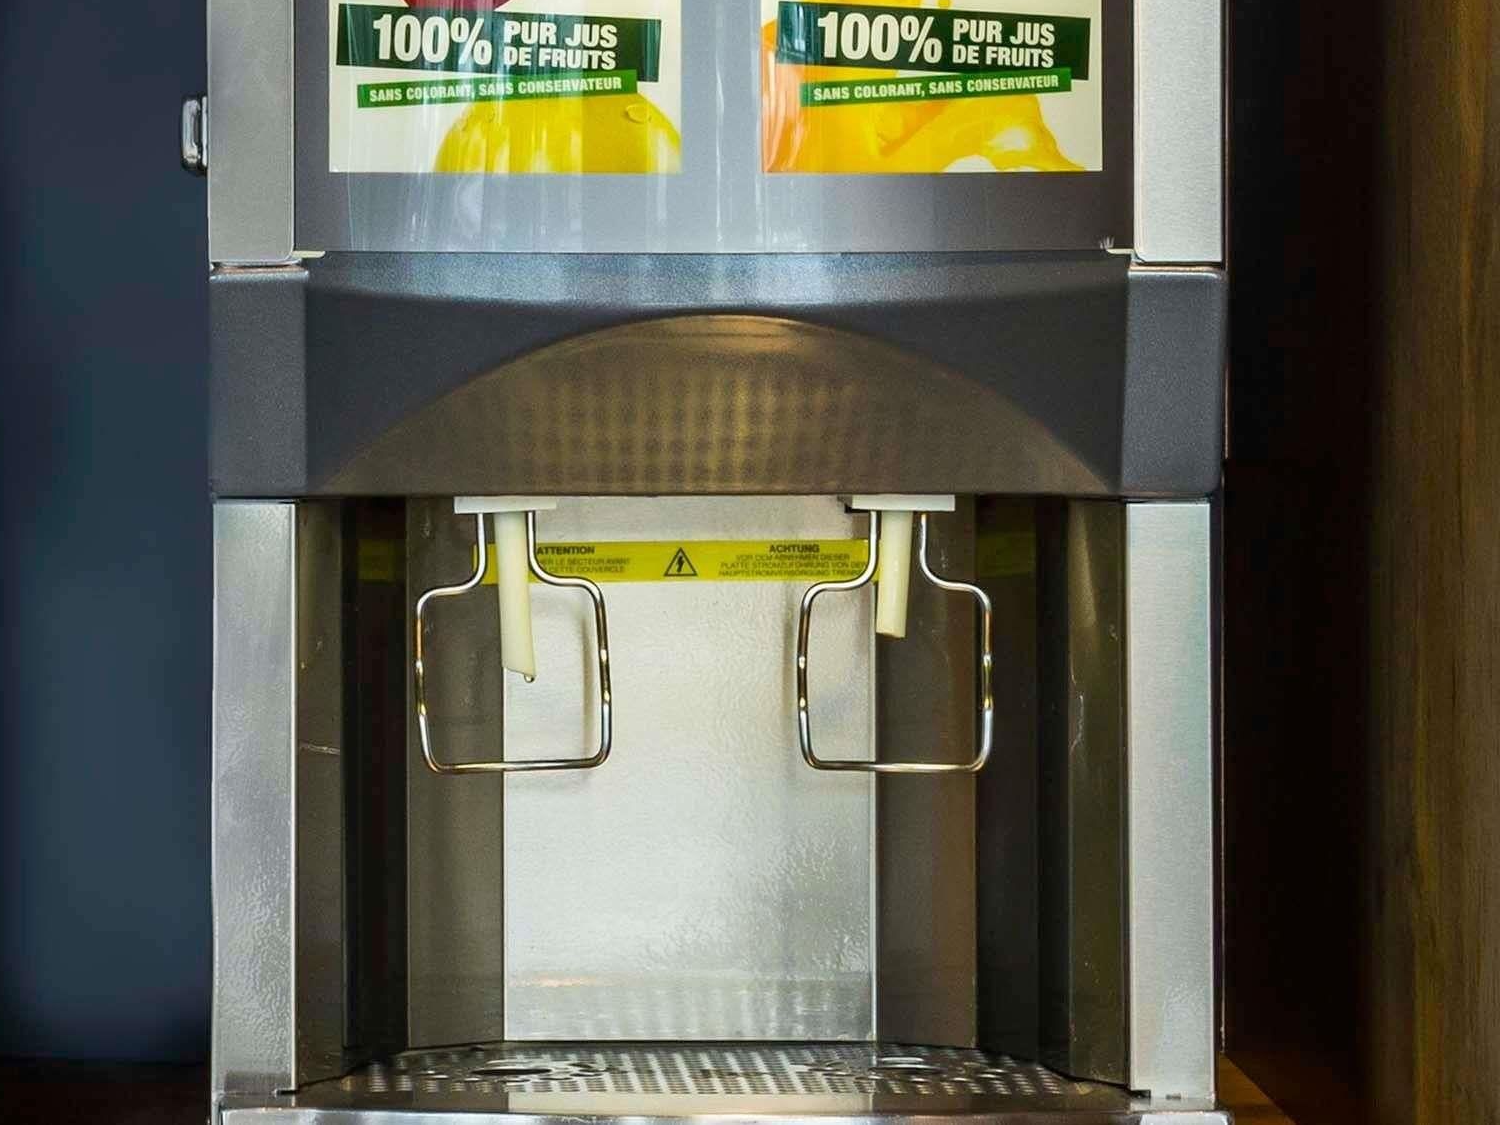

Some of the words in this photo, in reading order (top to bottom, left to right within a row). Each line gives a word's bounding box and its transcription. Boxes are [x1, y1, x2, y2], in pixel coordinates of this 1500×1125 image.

[373, 14, 492, 65] 100%
[504, 21, 556, 46] PUR
[565, 23, 617, 48] JUS
[817, 11, 942, 63] 100%
[953, 18, 1002, 43] PUR
[1009, 21, 1055, 45] JUS
[504, 49, 531, 67] DE
[538, 49, 617, 70] FRUITS
[953, 45, 980, 65] DE
[986, 46, 1054, 68] FRUITS
[369, 87, 402, 102] SANS
[406, 83, 475, 100] COLORANT,
[479, 79, 514, 96] SANS
[518, 76, 623, 94] CONSERVATEUR
[813, 86, 850, 101] SANS
[854, 81, 926, 98] COLORANT,
[929, 79, 963, 95] SANS
[966, 74, 1059, 93] CONSERVATEUR
[537, 546, 596, 555] ATTENTION
[769, 544, 821, 553] ACHTUNG
